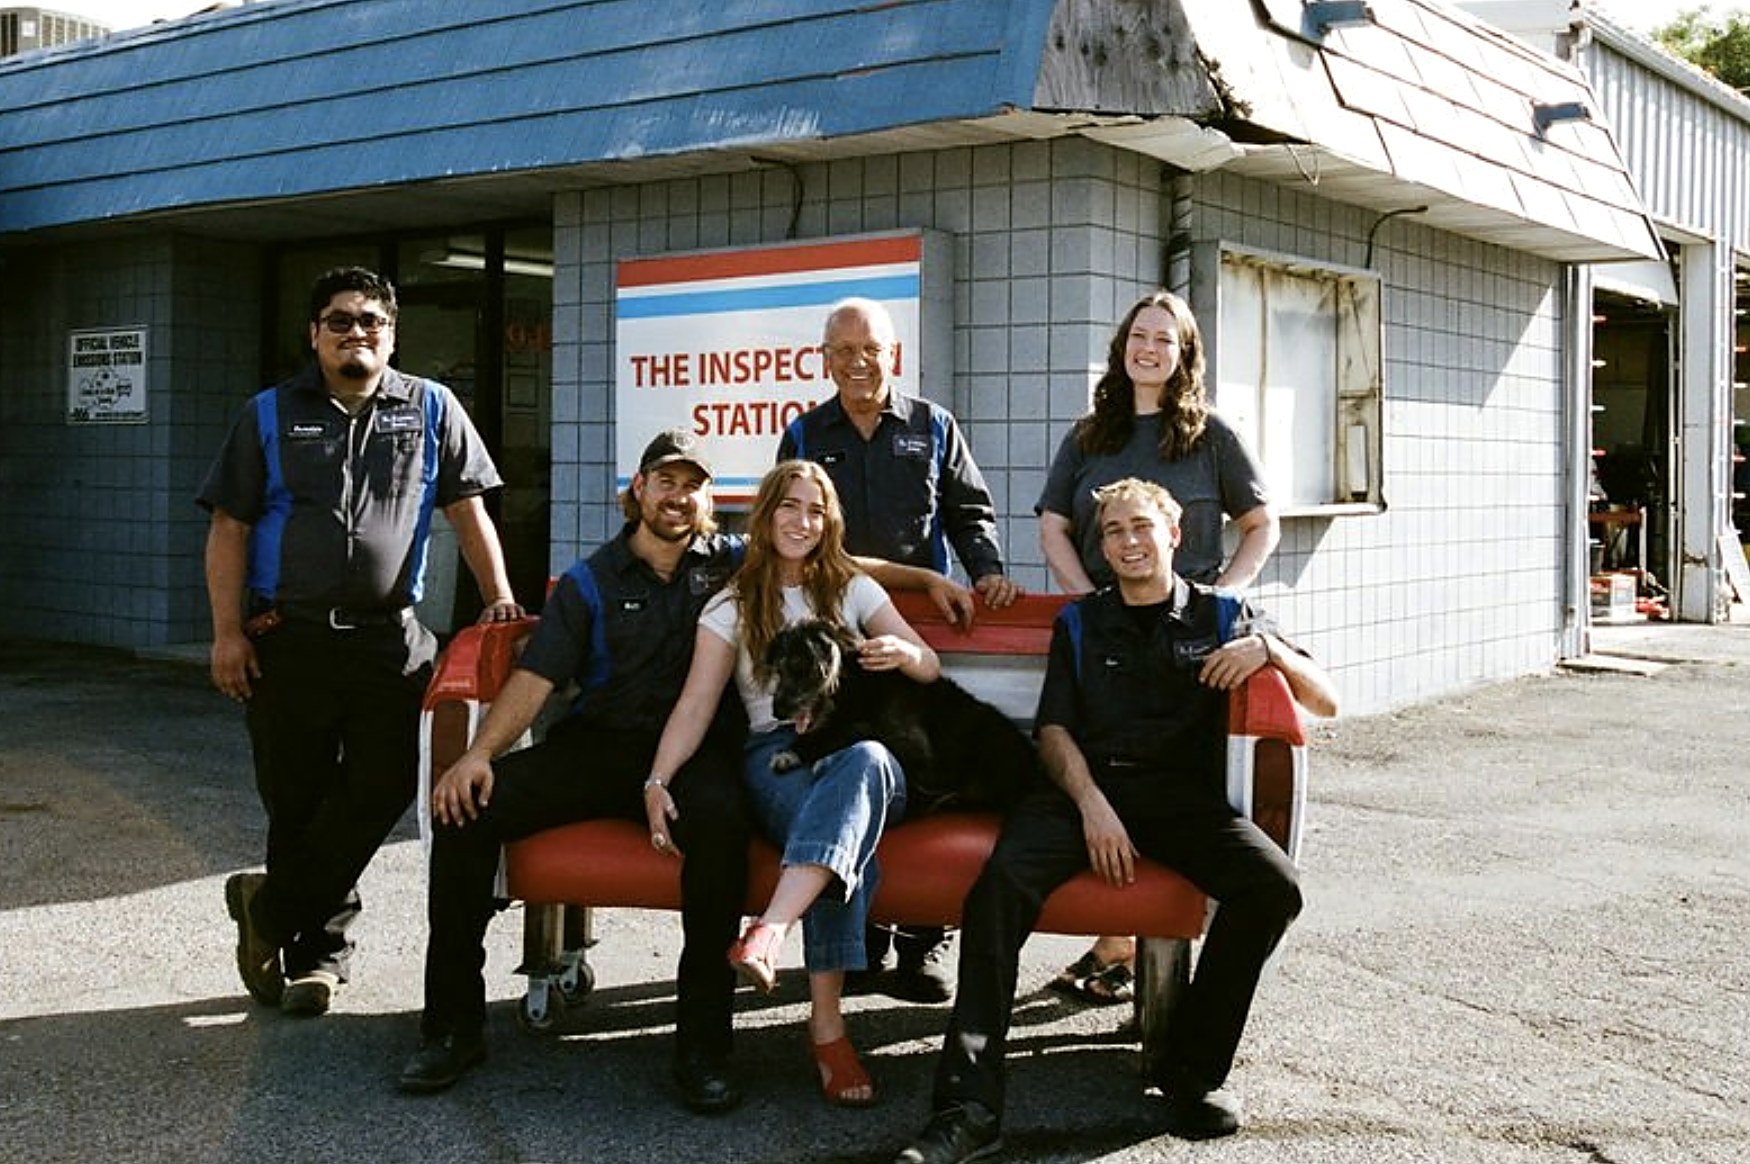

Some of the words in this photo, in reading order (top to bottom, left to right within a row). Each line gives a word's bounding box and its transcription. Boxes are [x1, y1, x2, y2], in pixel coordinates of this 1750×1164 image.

[630, 354, 690, 387] THE
[699, 341, 902, 384] INSPECTN
[693, 401, 817, 436] STATIO
